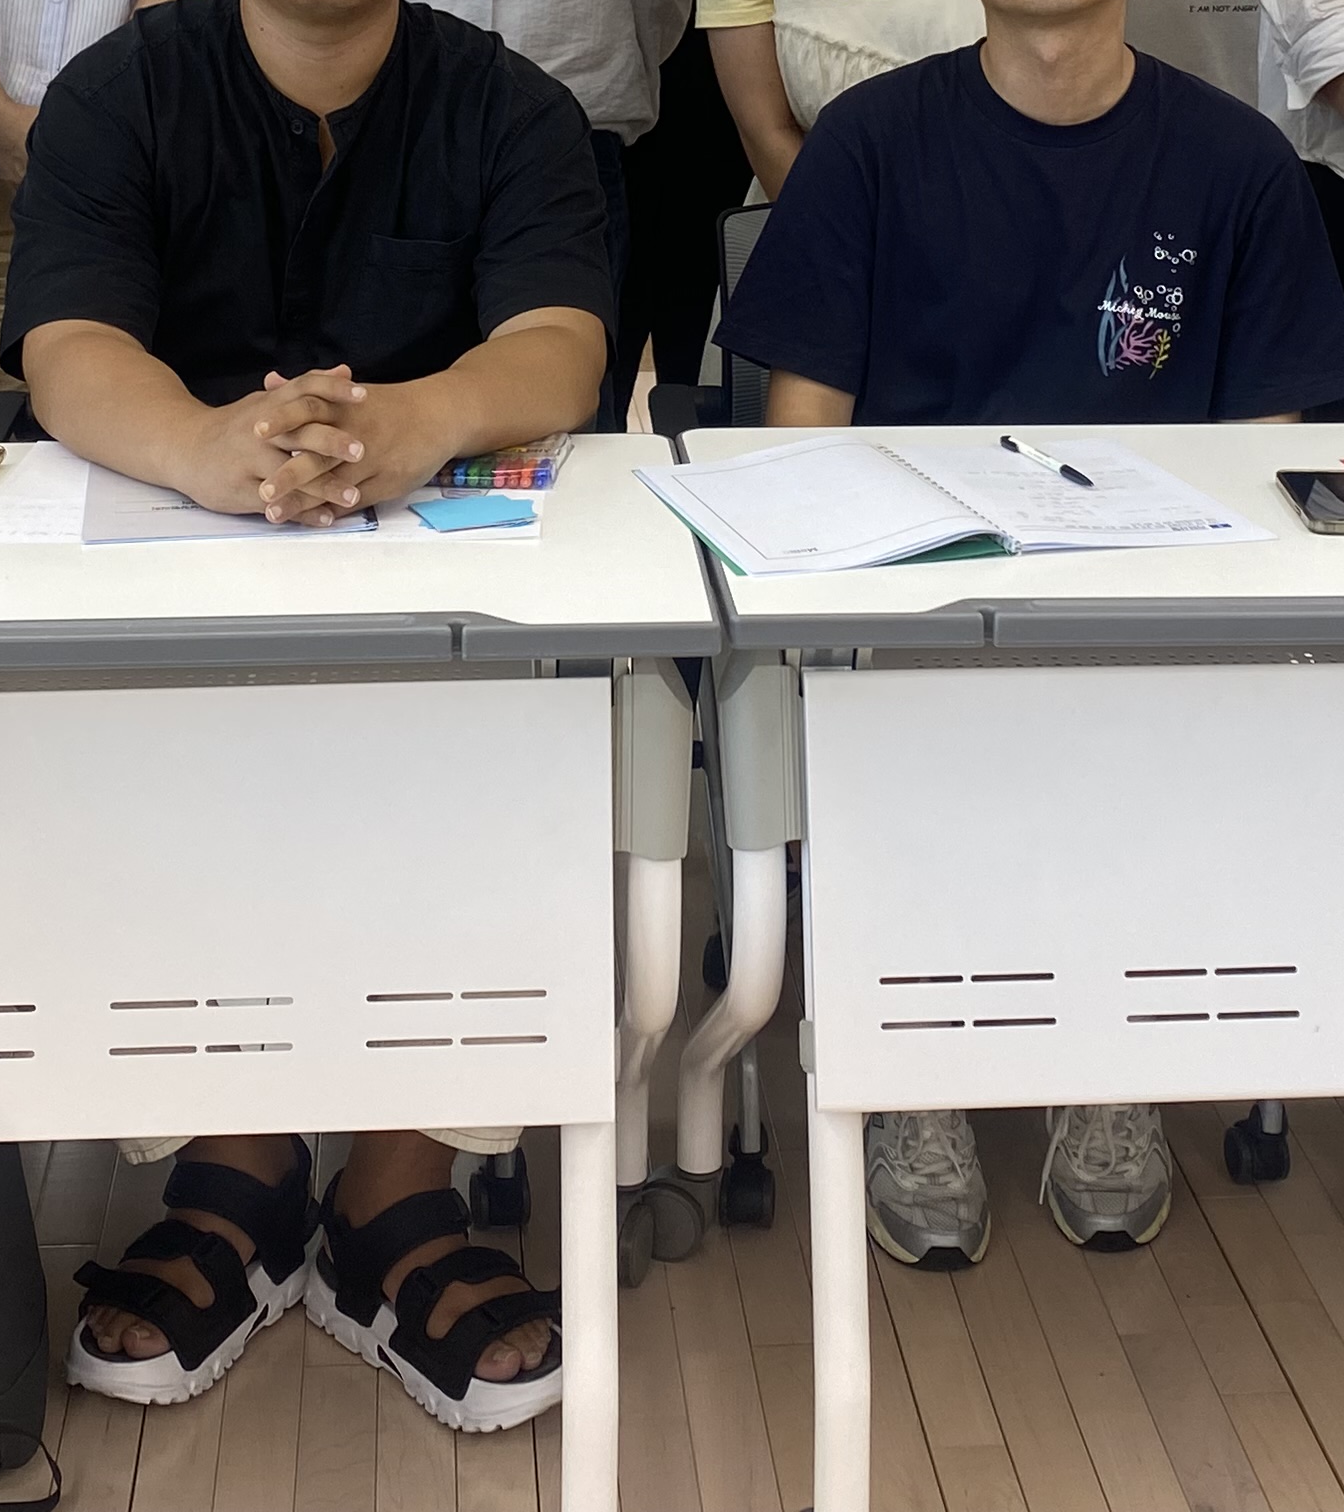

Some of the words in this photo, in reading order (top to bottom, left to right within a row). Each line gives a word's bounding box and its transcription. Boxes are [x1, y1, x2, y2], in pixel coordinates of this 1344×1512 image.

[1212, 5, 1231, 13] NOT
[1232, 4, 1259, 12] ANGRY
[1097, 299, 1144, 323] Mickey
[1144, 307, 1182, 321] Mouse
